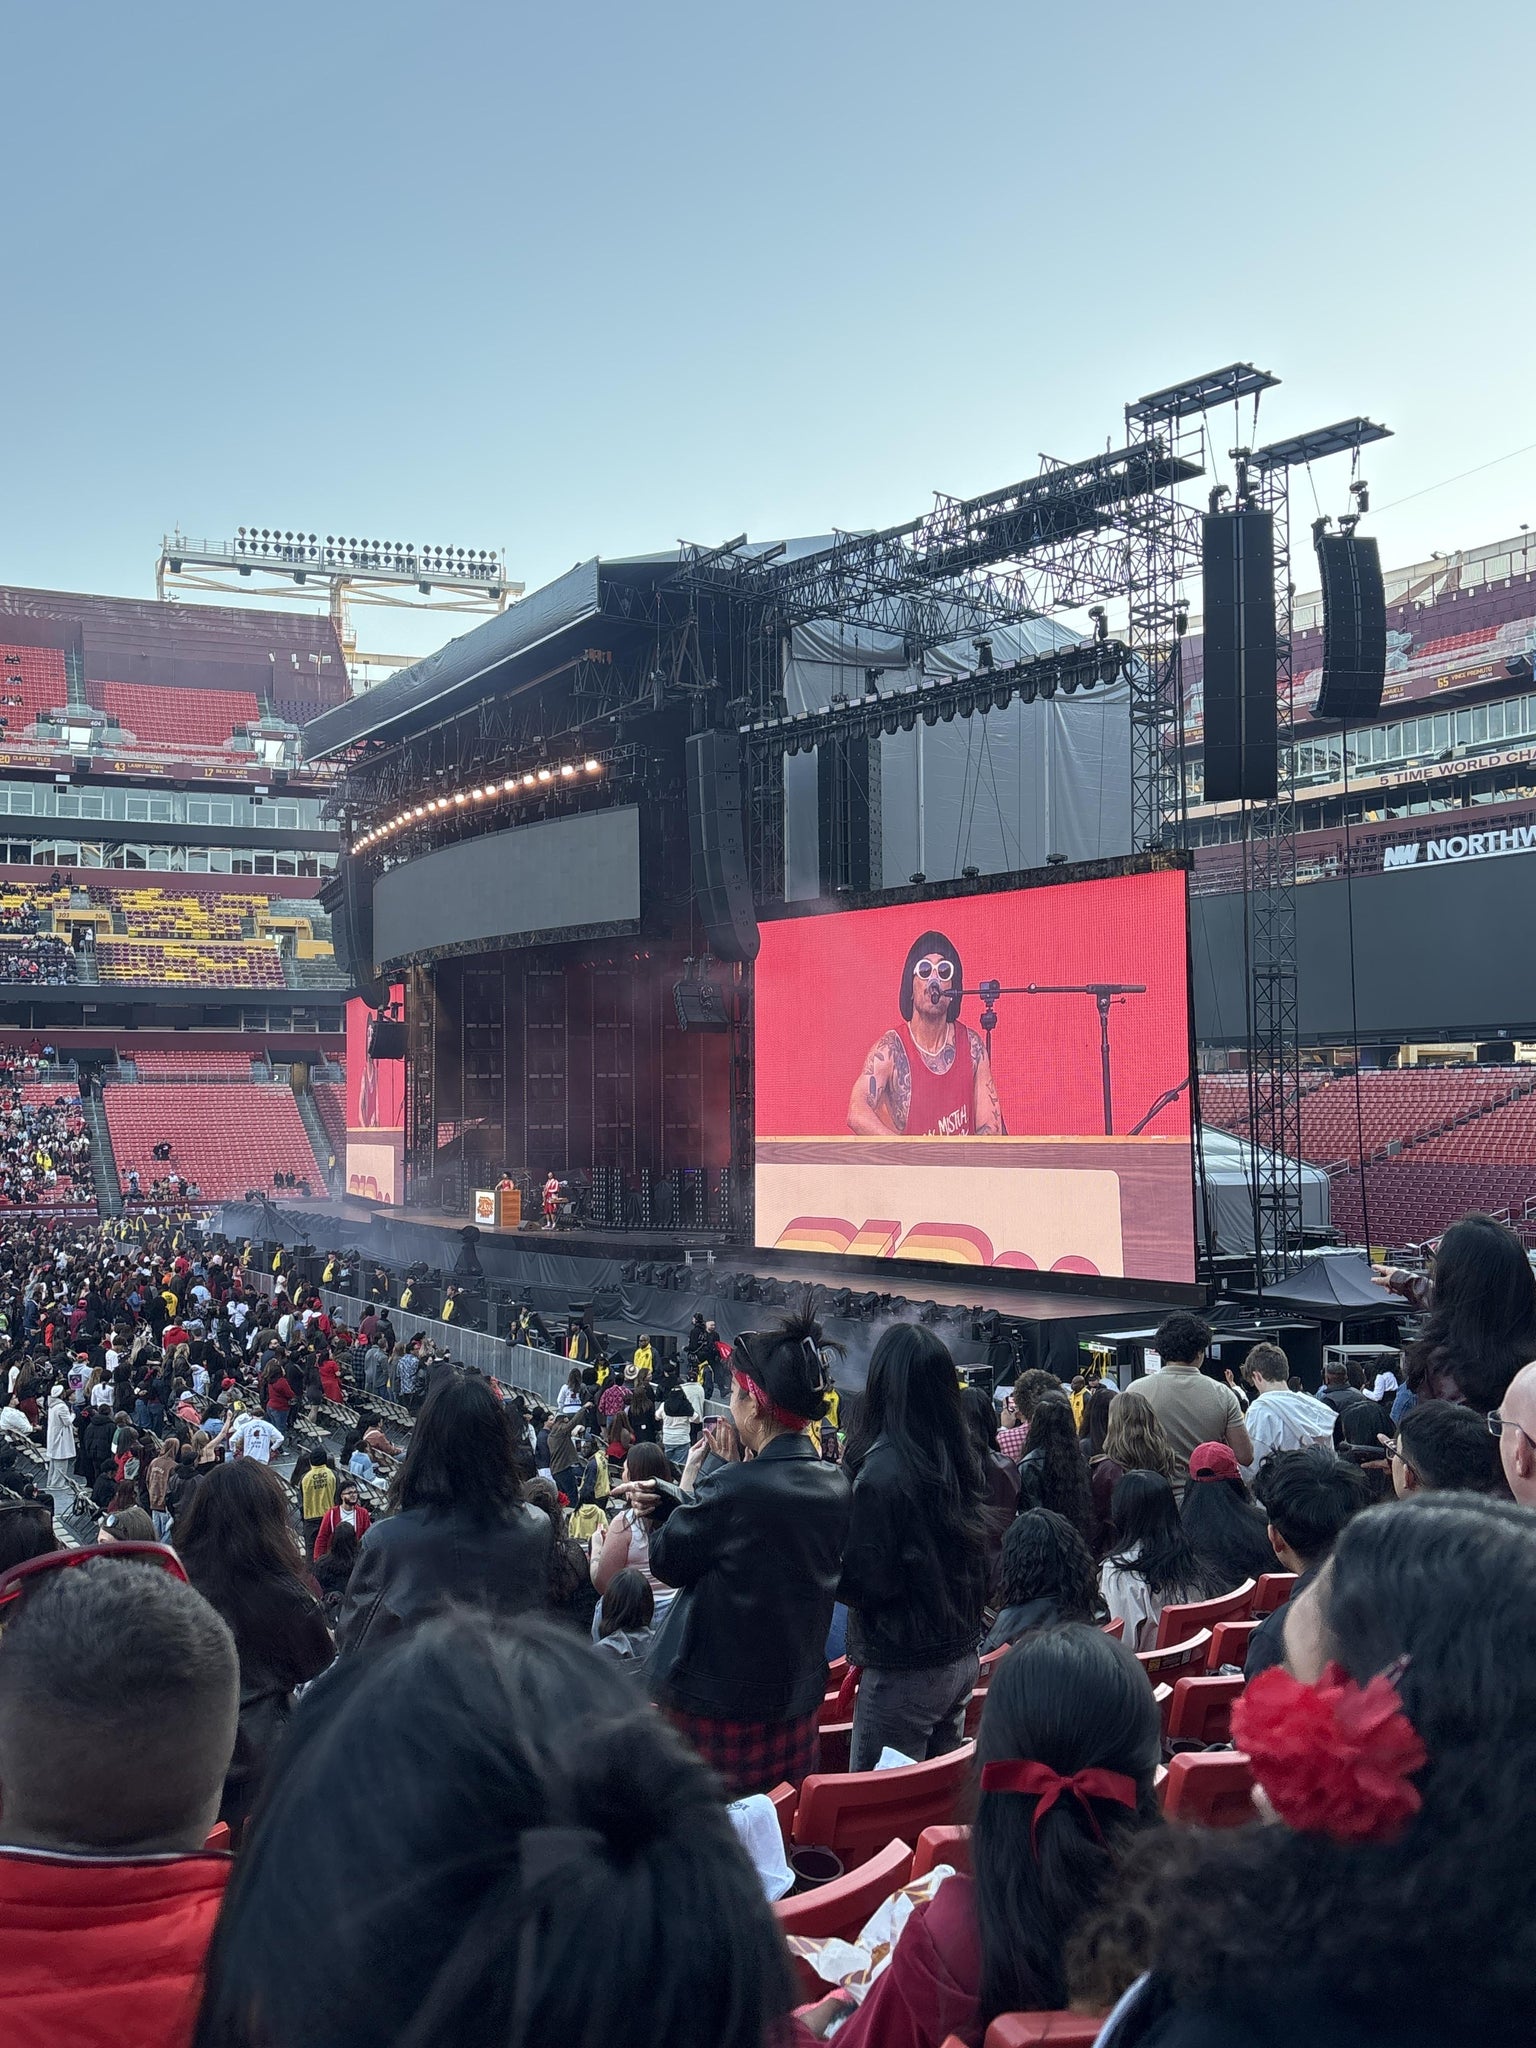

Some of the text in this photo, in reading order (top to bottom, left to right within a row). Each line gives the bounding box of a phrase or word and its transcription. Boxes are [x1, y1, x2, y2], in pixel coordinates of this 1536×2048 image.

[1437, 676, 1449, 688] 65
[0, 755, 10, 764] 20
[114, 762, 126, 771] 43
[1380, 775, 1388, 785] 5
[1394, 768, 1433, 783] TIME
[1438, 755, 1501, 775] WORLD
[204, 767, 214, 777] 17
